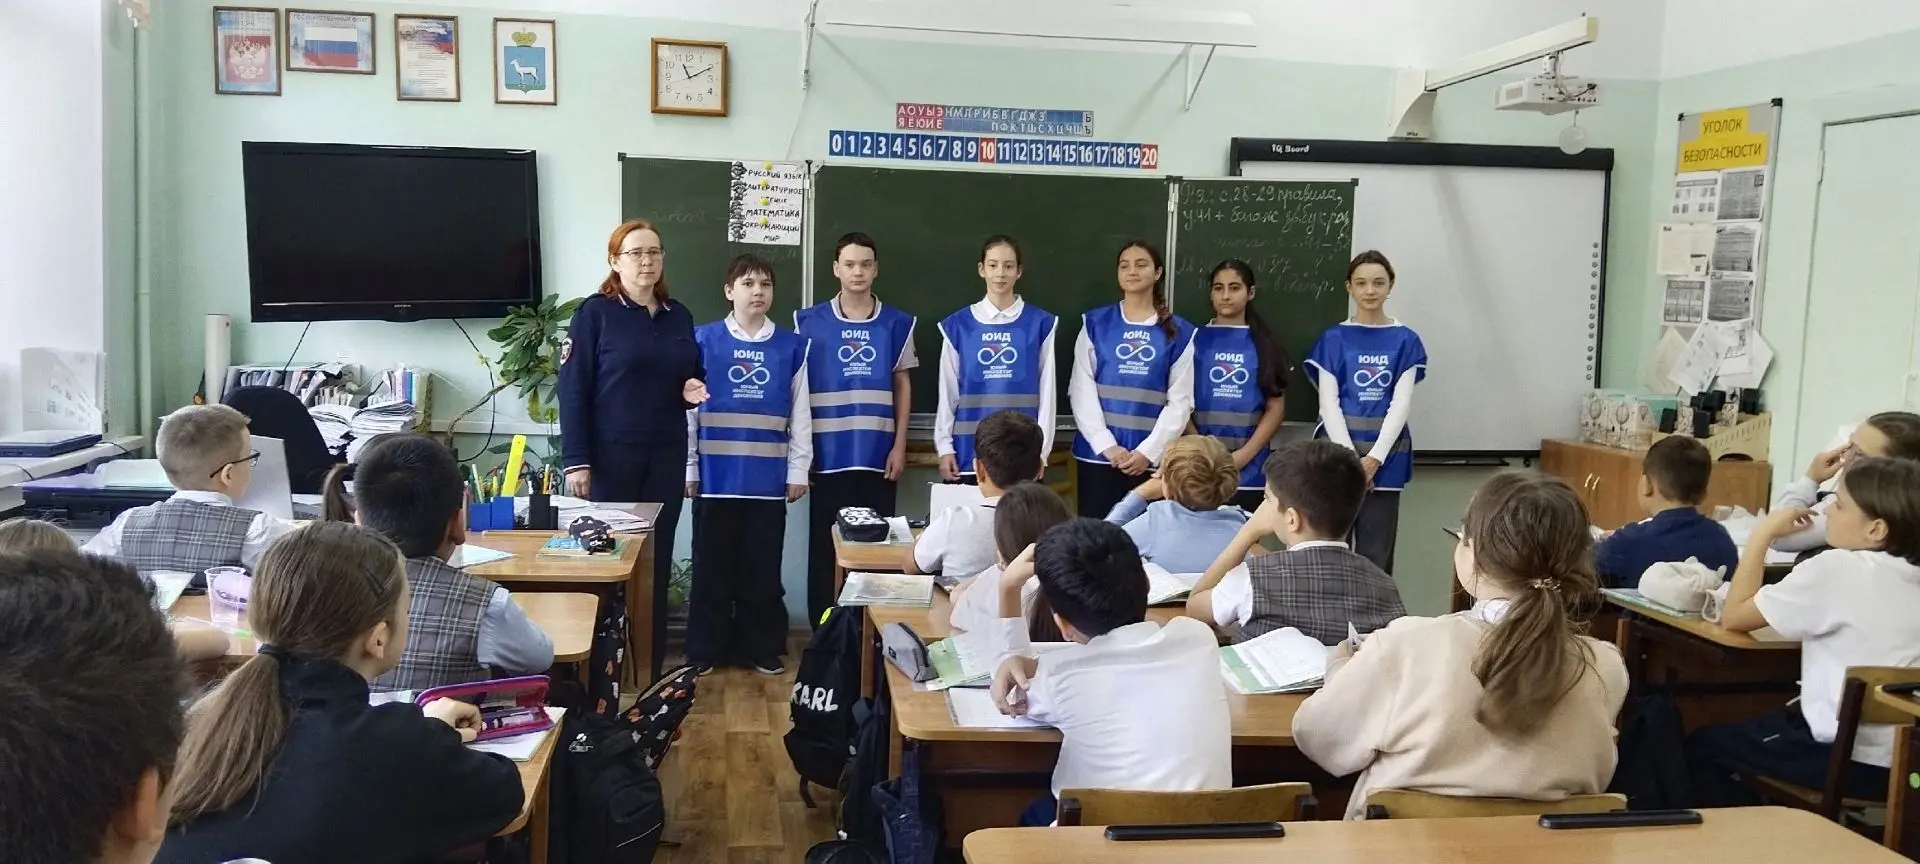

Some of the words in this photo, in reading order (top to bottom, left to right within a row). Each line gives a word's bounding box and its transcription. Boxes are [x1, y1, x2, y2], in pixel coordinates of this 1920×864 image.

[1703, 118, 1743, 134] УГОЛОК
[832, 134, 841, 152] 0
[848, 135, 855, 153] 1
[862, 136, 871, 154] 2
[877, 136, 886, 155] 3
[892, 137, 902, 155] 4
[908, 138, 917, 156] 5
[922, 139, 932, 157] 6
[938, 139, 947, 157] 7
[952, 140, 962, 158] 8
[967, 141, 976, 159] 9
[981, 141, 995, 160] 10
[997, 142, 1010, 160] 11
[1014, 143, 1027, 161] 12
[1030, 143, 1044, 161] 13
[1046, 144, 1061, 162] 14
[1063, 144, 1076, 162] 15
[1079, 145, 1093, 163] 16
[1095, 145, 1109, 164] 17
[1112, 146, 1125, 164] 18
[1127, 147, 1140, 165] 19
[1142, 147, 1157, 165] 20
[1284, 144, 1310, 153] Board
[1683, 143, 1762, 163] БЕЗОПАСНОСТИ
[748, 169, 781, 178] РУССКИЙ
[746, 209, 800, 217] МАТЕМАТИКА
[841, 329, 870, 341] ЮИД
[981, 332, 1011, 342] ЮИД
[1123, 330, 1151, 342] ЮИД
[733, 349, 765, 362] ЮИД
[1215, 352, 1244, 363] ЮИД
[1358, 354, 1389, 365] ЮИД
[791, 681, 839, 712] KARL
